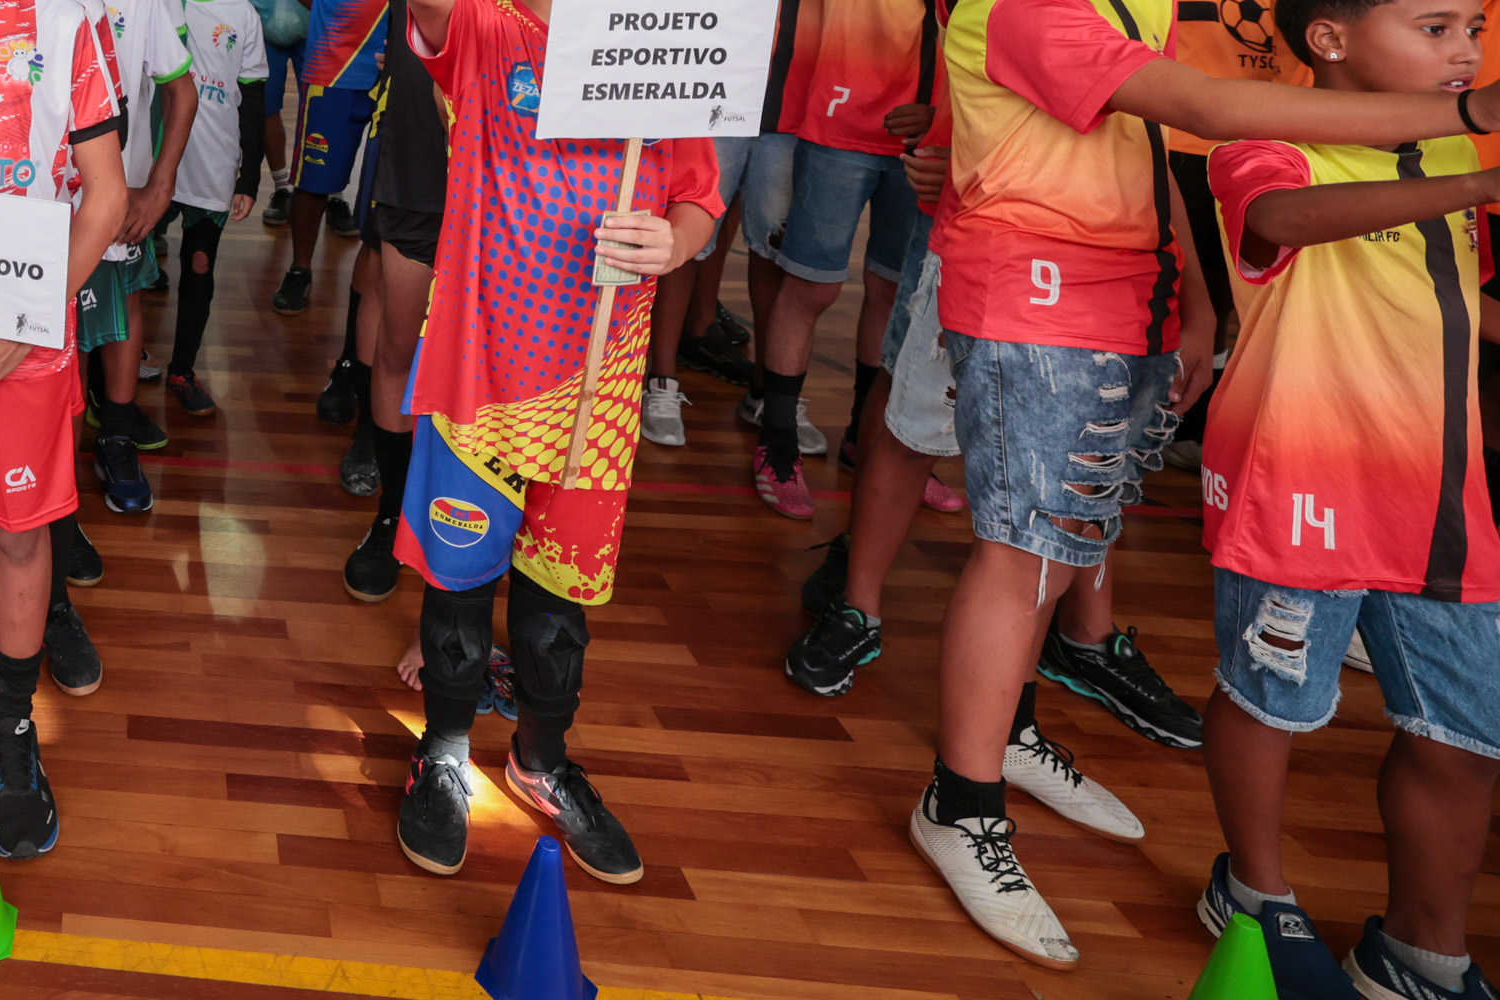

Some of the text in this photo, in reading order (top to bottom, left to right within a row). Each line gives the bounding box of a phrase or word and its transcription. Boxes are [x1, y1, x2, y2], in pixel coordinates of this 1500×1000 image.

[608, 12, 718, 31] PROJETO
[591, 47, 727, 66] ESPORTIVO
[582, 82, 727, 101] ESMERALDA
[1386, 231, 1400, 242] FC
[1029, 258, 1061, 306] 9
[29, 325, 50, 334] FUTSAL
[5, 465, 37, 487] CA
[434, 511, 484, 530] ESMERALDA
[1291, 493, 1336, 550] 14
